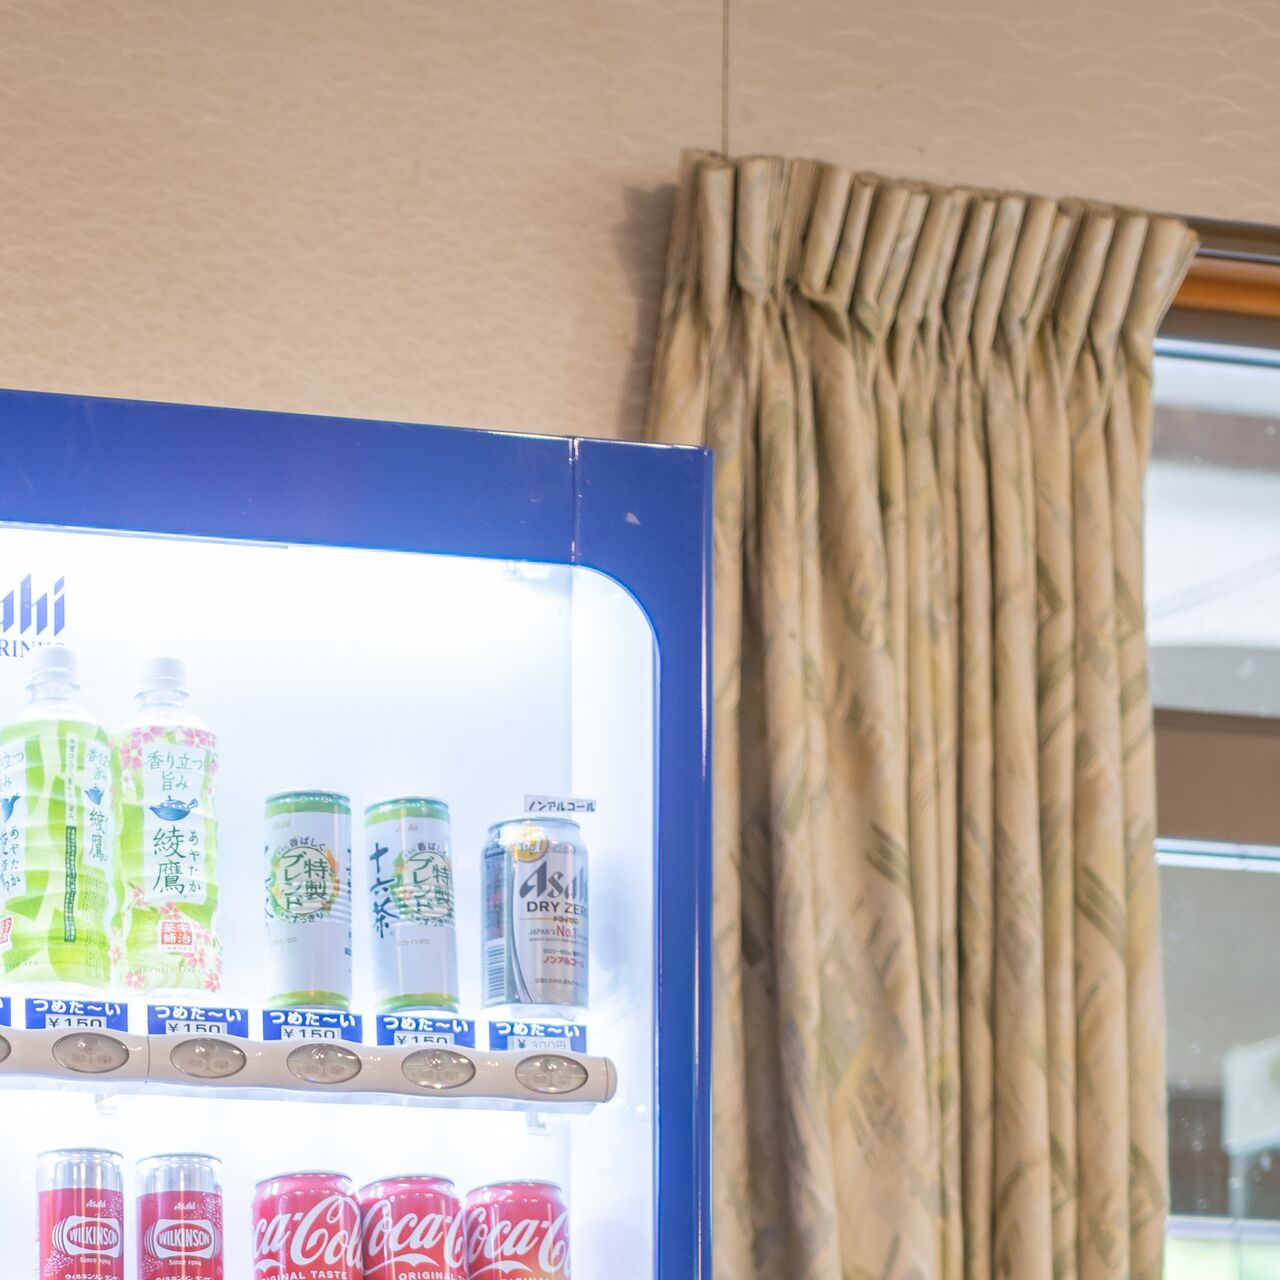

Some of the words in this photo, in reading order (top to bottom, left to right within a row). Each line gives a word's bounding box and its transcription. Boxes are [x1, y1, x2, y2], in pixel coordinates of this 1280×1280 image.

[146, 750, 203, 771] 香り立つ
[161, 771, 189, 792] 旨み
[527, 800, 596, 813] ノンアルコール
[152, 824, 187, 895] 綾鷹
[188, 829, 202, 893] あやたか
[282, 852, 306, 910] ブレンド
[303, 857, 329, 901] 特製
[369, 842, 401, 939] 十六茶
[526, 900, 560, 913] DRY
[69, 1223, 119, 1246] WILKINSON
[158, 1226, 211, 1247] WILKINSON
[310, 1270, 348, 1280] TASTE
